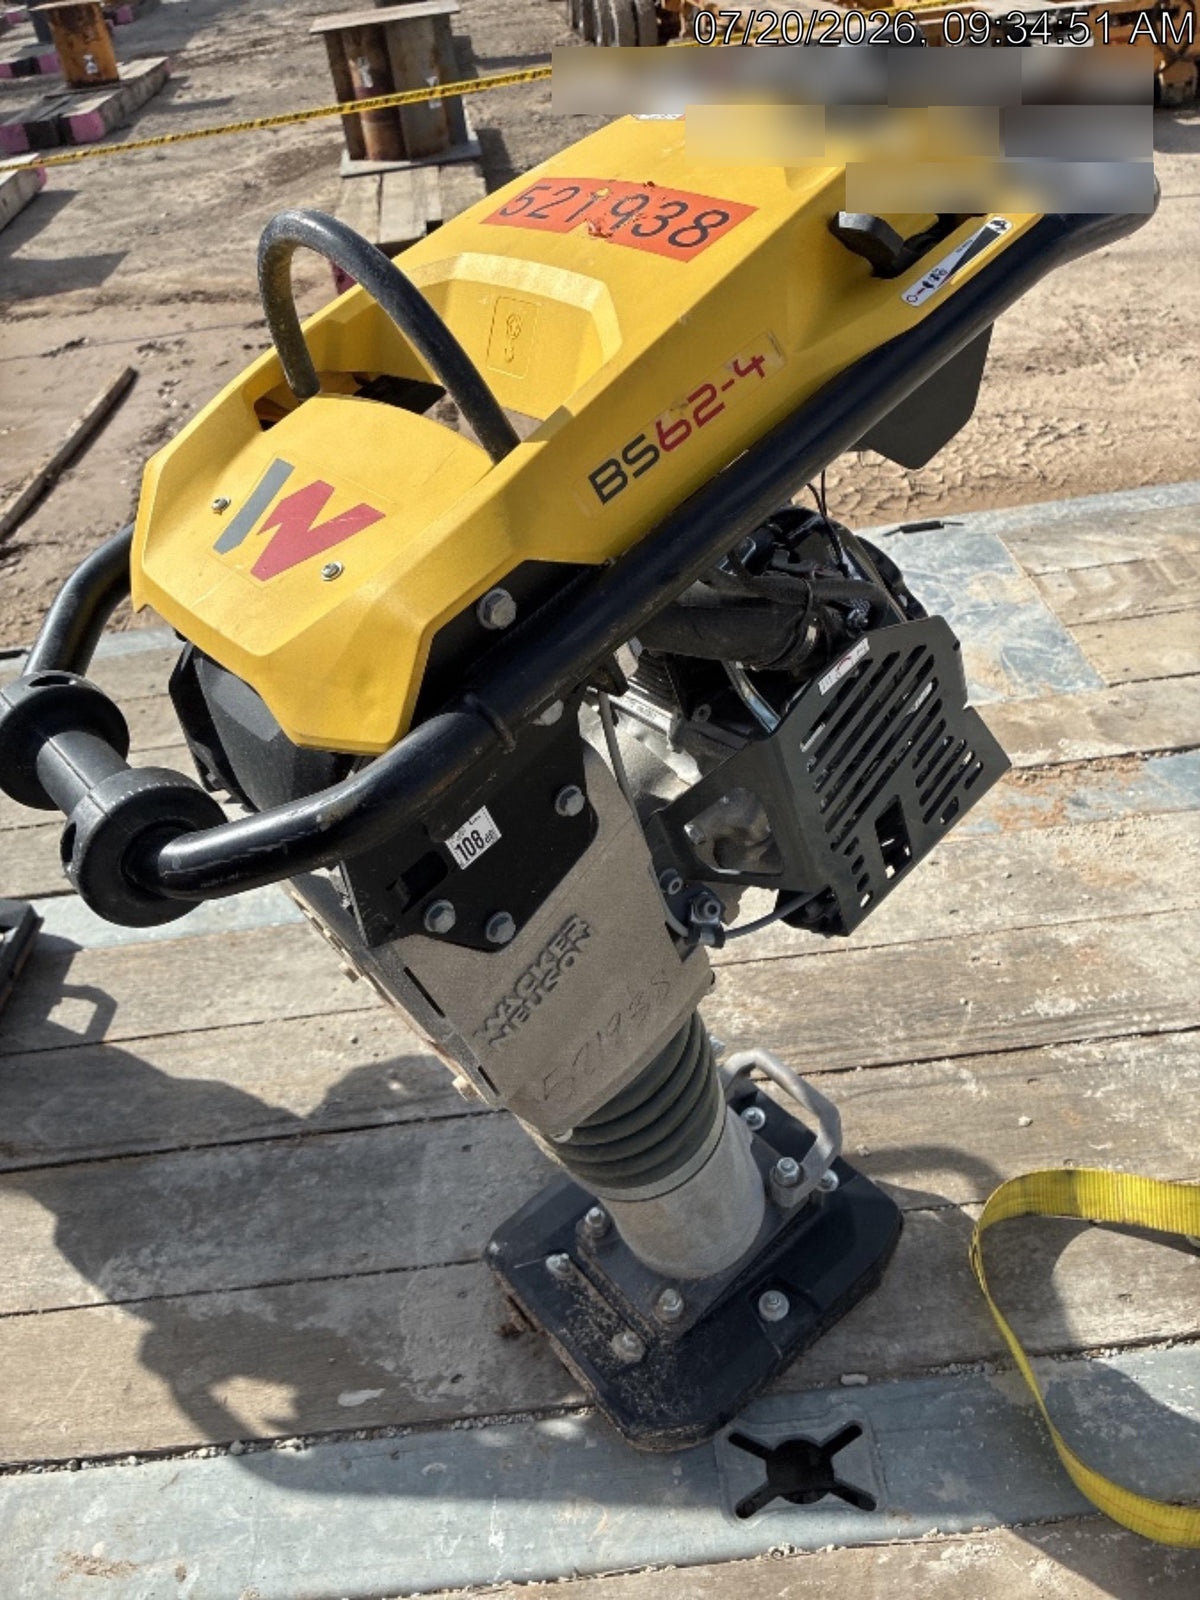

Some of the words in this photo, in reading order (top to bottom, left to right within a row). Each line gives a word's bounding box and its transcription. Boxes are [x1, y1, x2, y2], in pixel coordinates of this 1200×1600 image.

[499, 185, 730, 248] 521938
[588, 355, 766, 505] BS62-4
[454, 830, 485, 861] 108
[470, 914, 588, 1034] WACKER
[486, 925, 597, 1050] NEUSON
